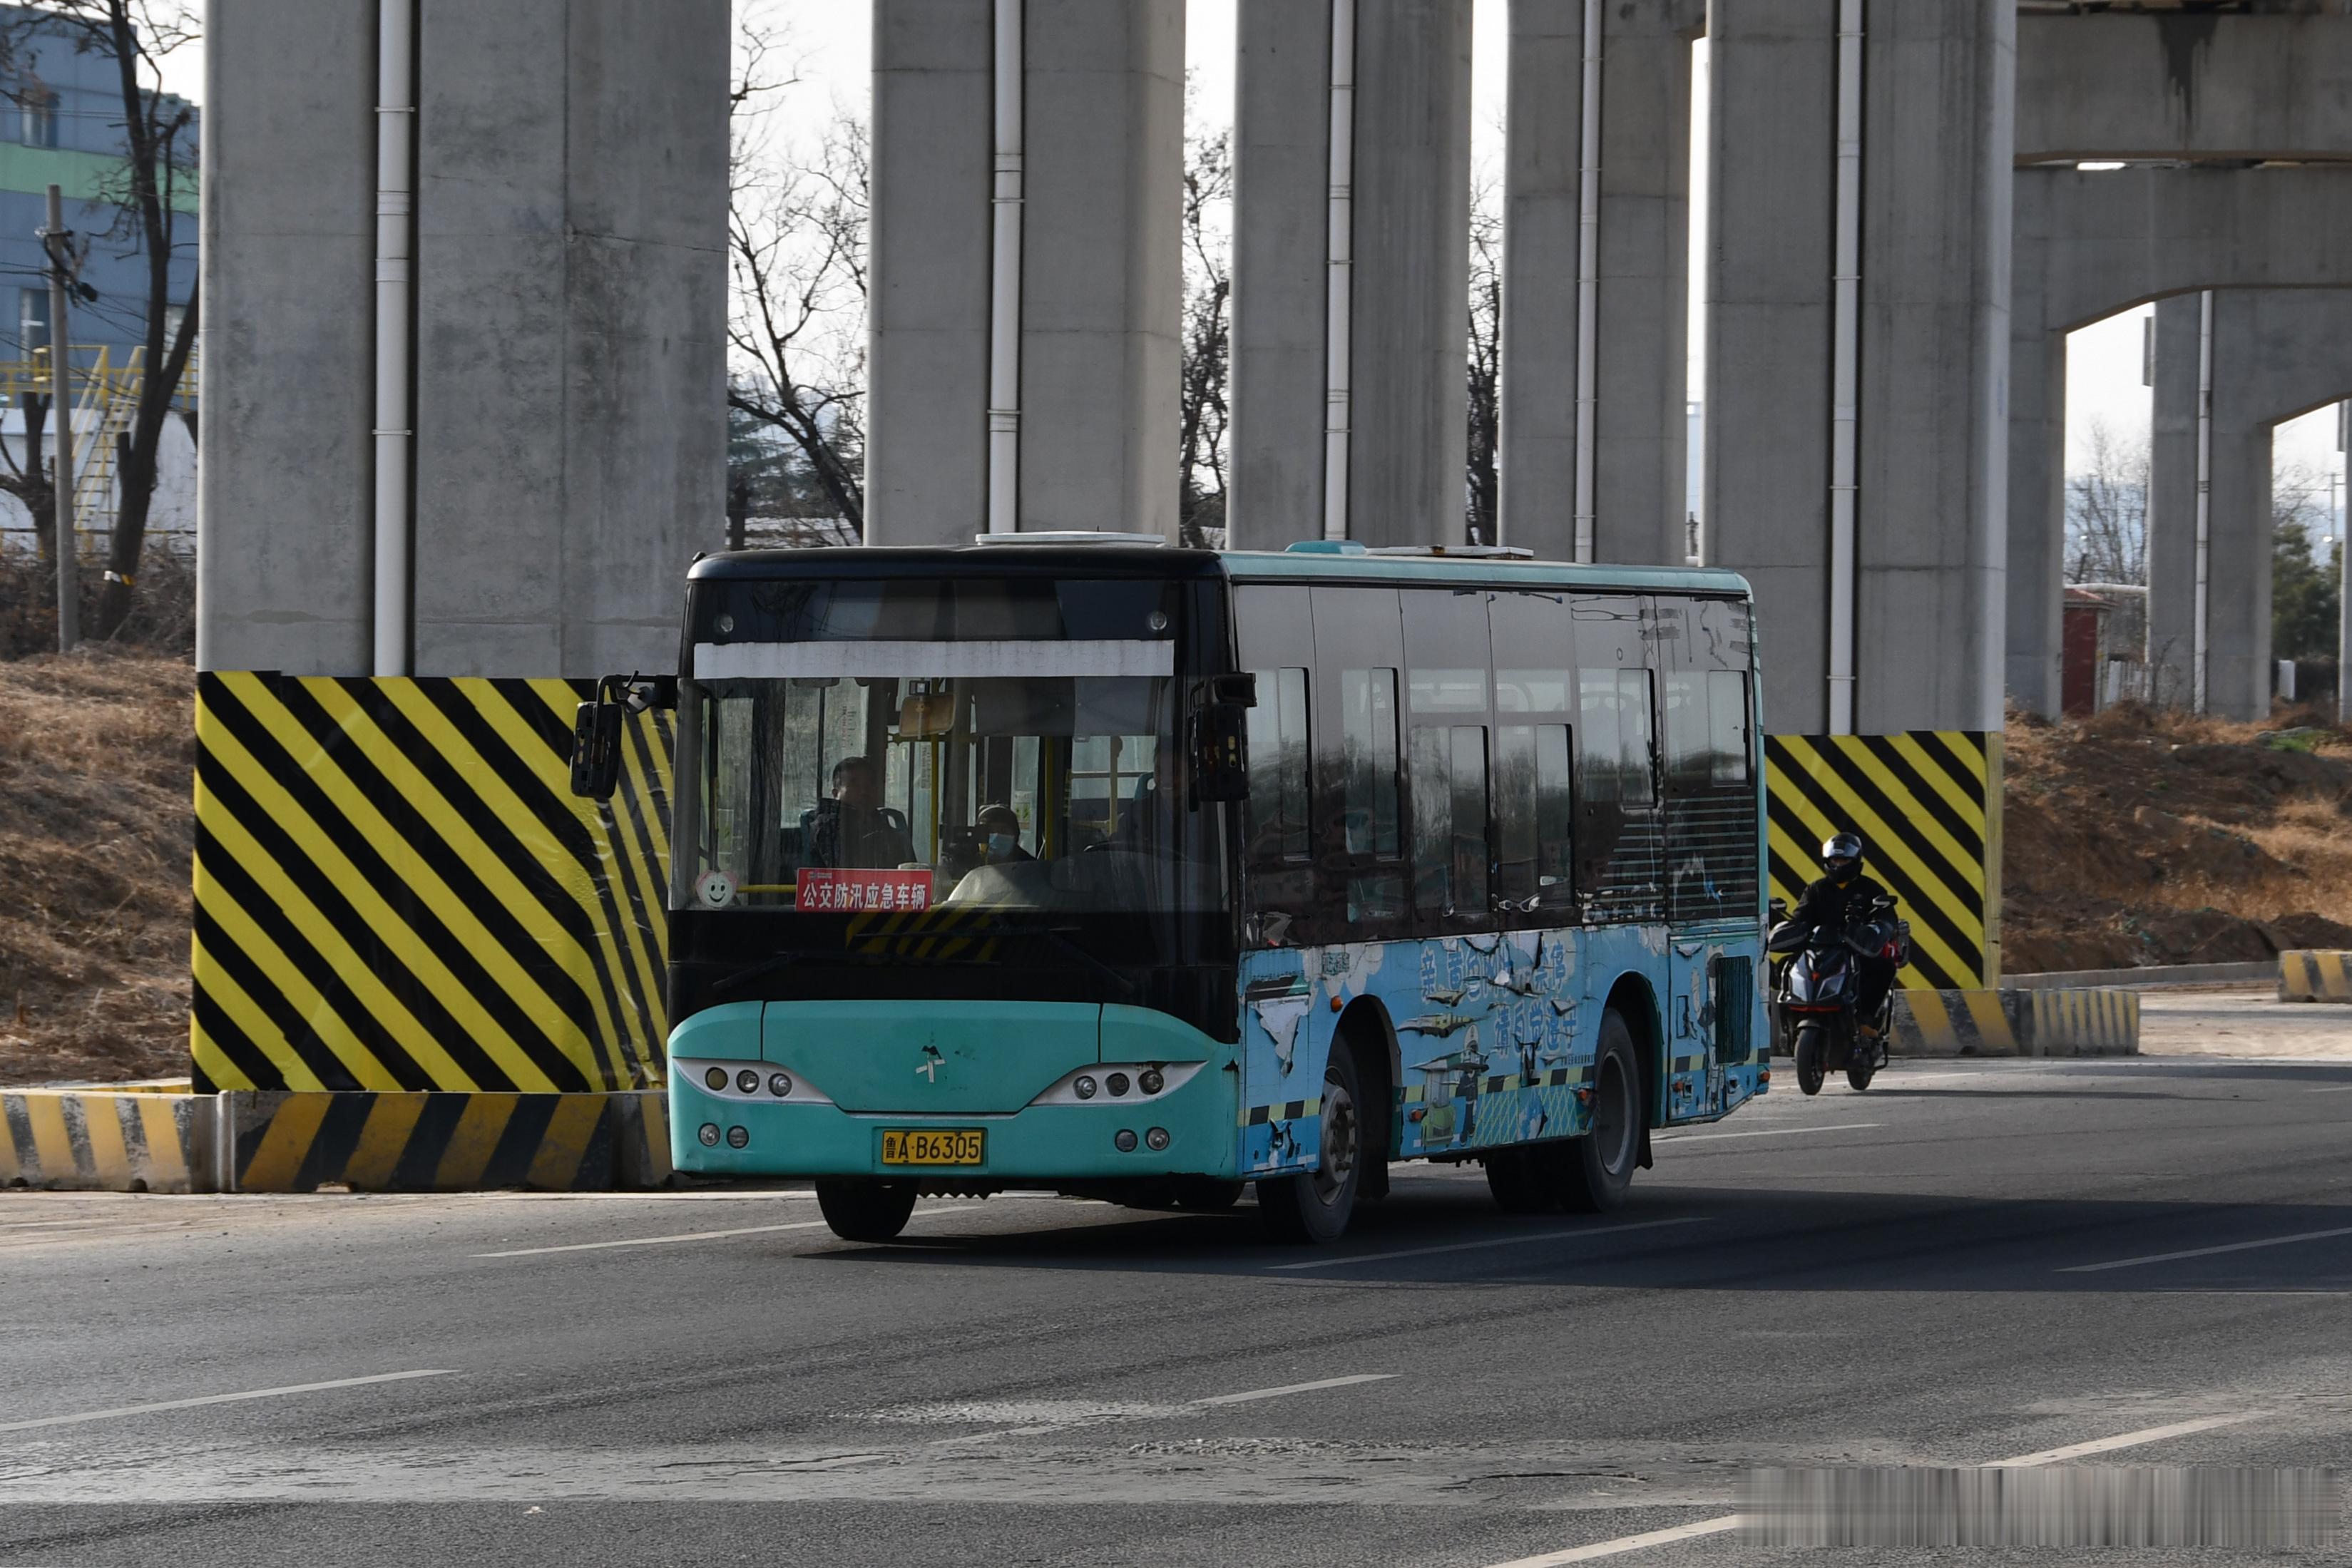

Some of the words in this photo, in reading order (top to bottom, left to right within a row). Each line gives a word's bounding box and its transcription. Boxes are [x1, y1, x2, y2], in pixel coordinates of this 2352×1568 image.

[803, 882, 926, 910] 公交防汛应急车辆
[1495, 999, 1577, 1057] 请自觉遵守
[885, 1135, 980, 1159] 鲁A·B6305
